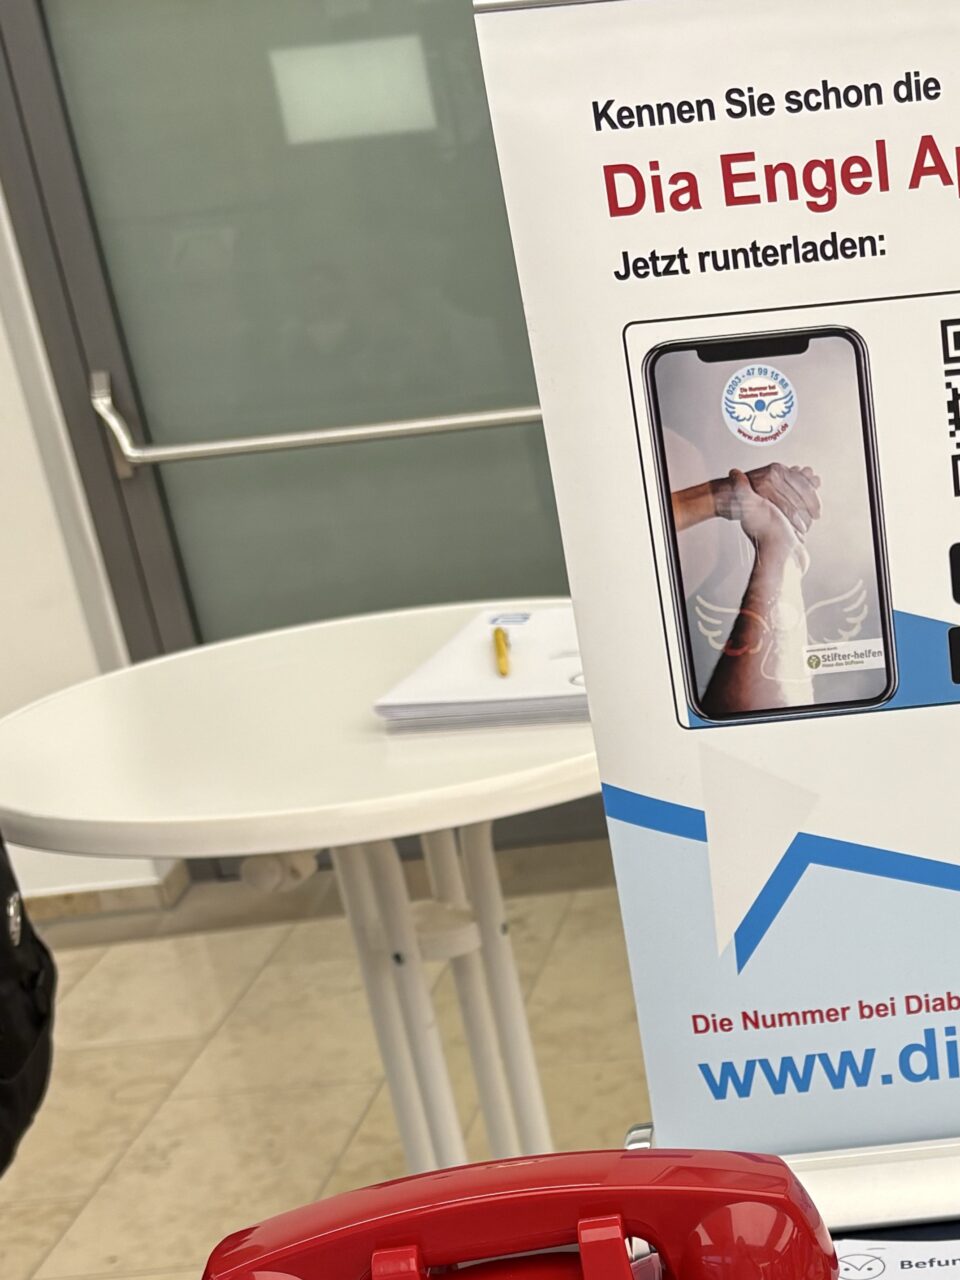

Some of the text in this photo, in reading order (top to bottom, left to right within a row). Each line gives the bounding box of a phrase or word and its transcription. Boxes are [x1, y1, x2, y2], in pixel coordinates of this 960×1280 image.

[592, 71, 941, 131] Kennen Sie schon die
[603, 160, 702, 217] Dia
[720, 140, 889, 213] Engel
[614, 232, 887, 281] Jetzt runterladen:
[822, 650, 882, 662] Stifter-helfen
[692, 1014, 732, 1035] Die
[741, 1004, 850, 1031] Nummer
[859, 998, 897, 1020] bei
